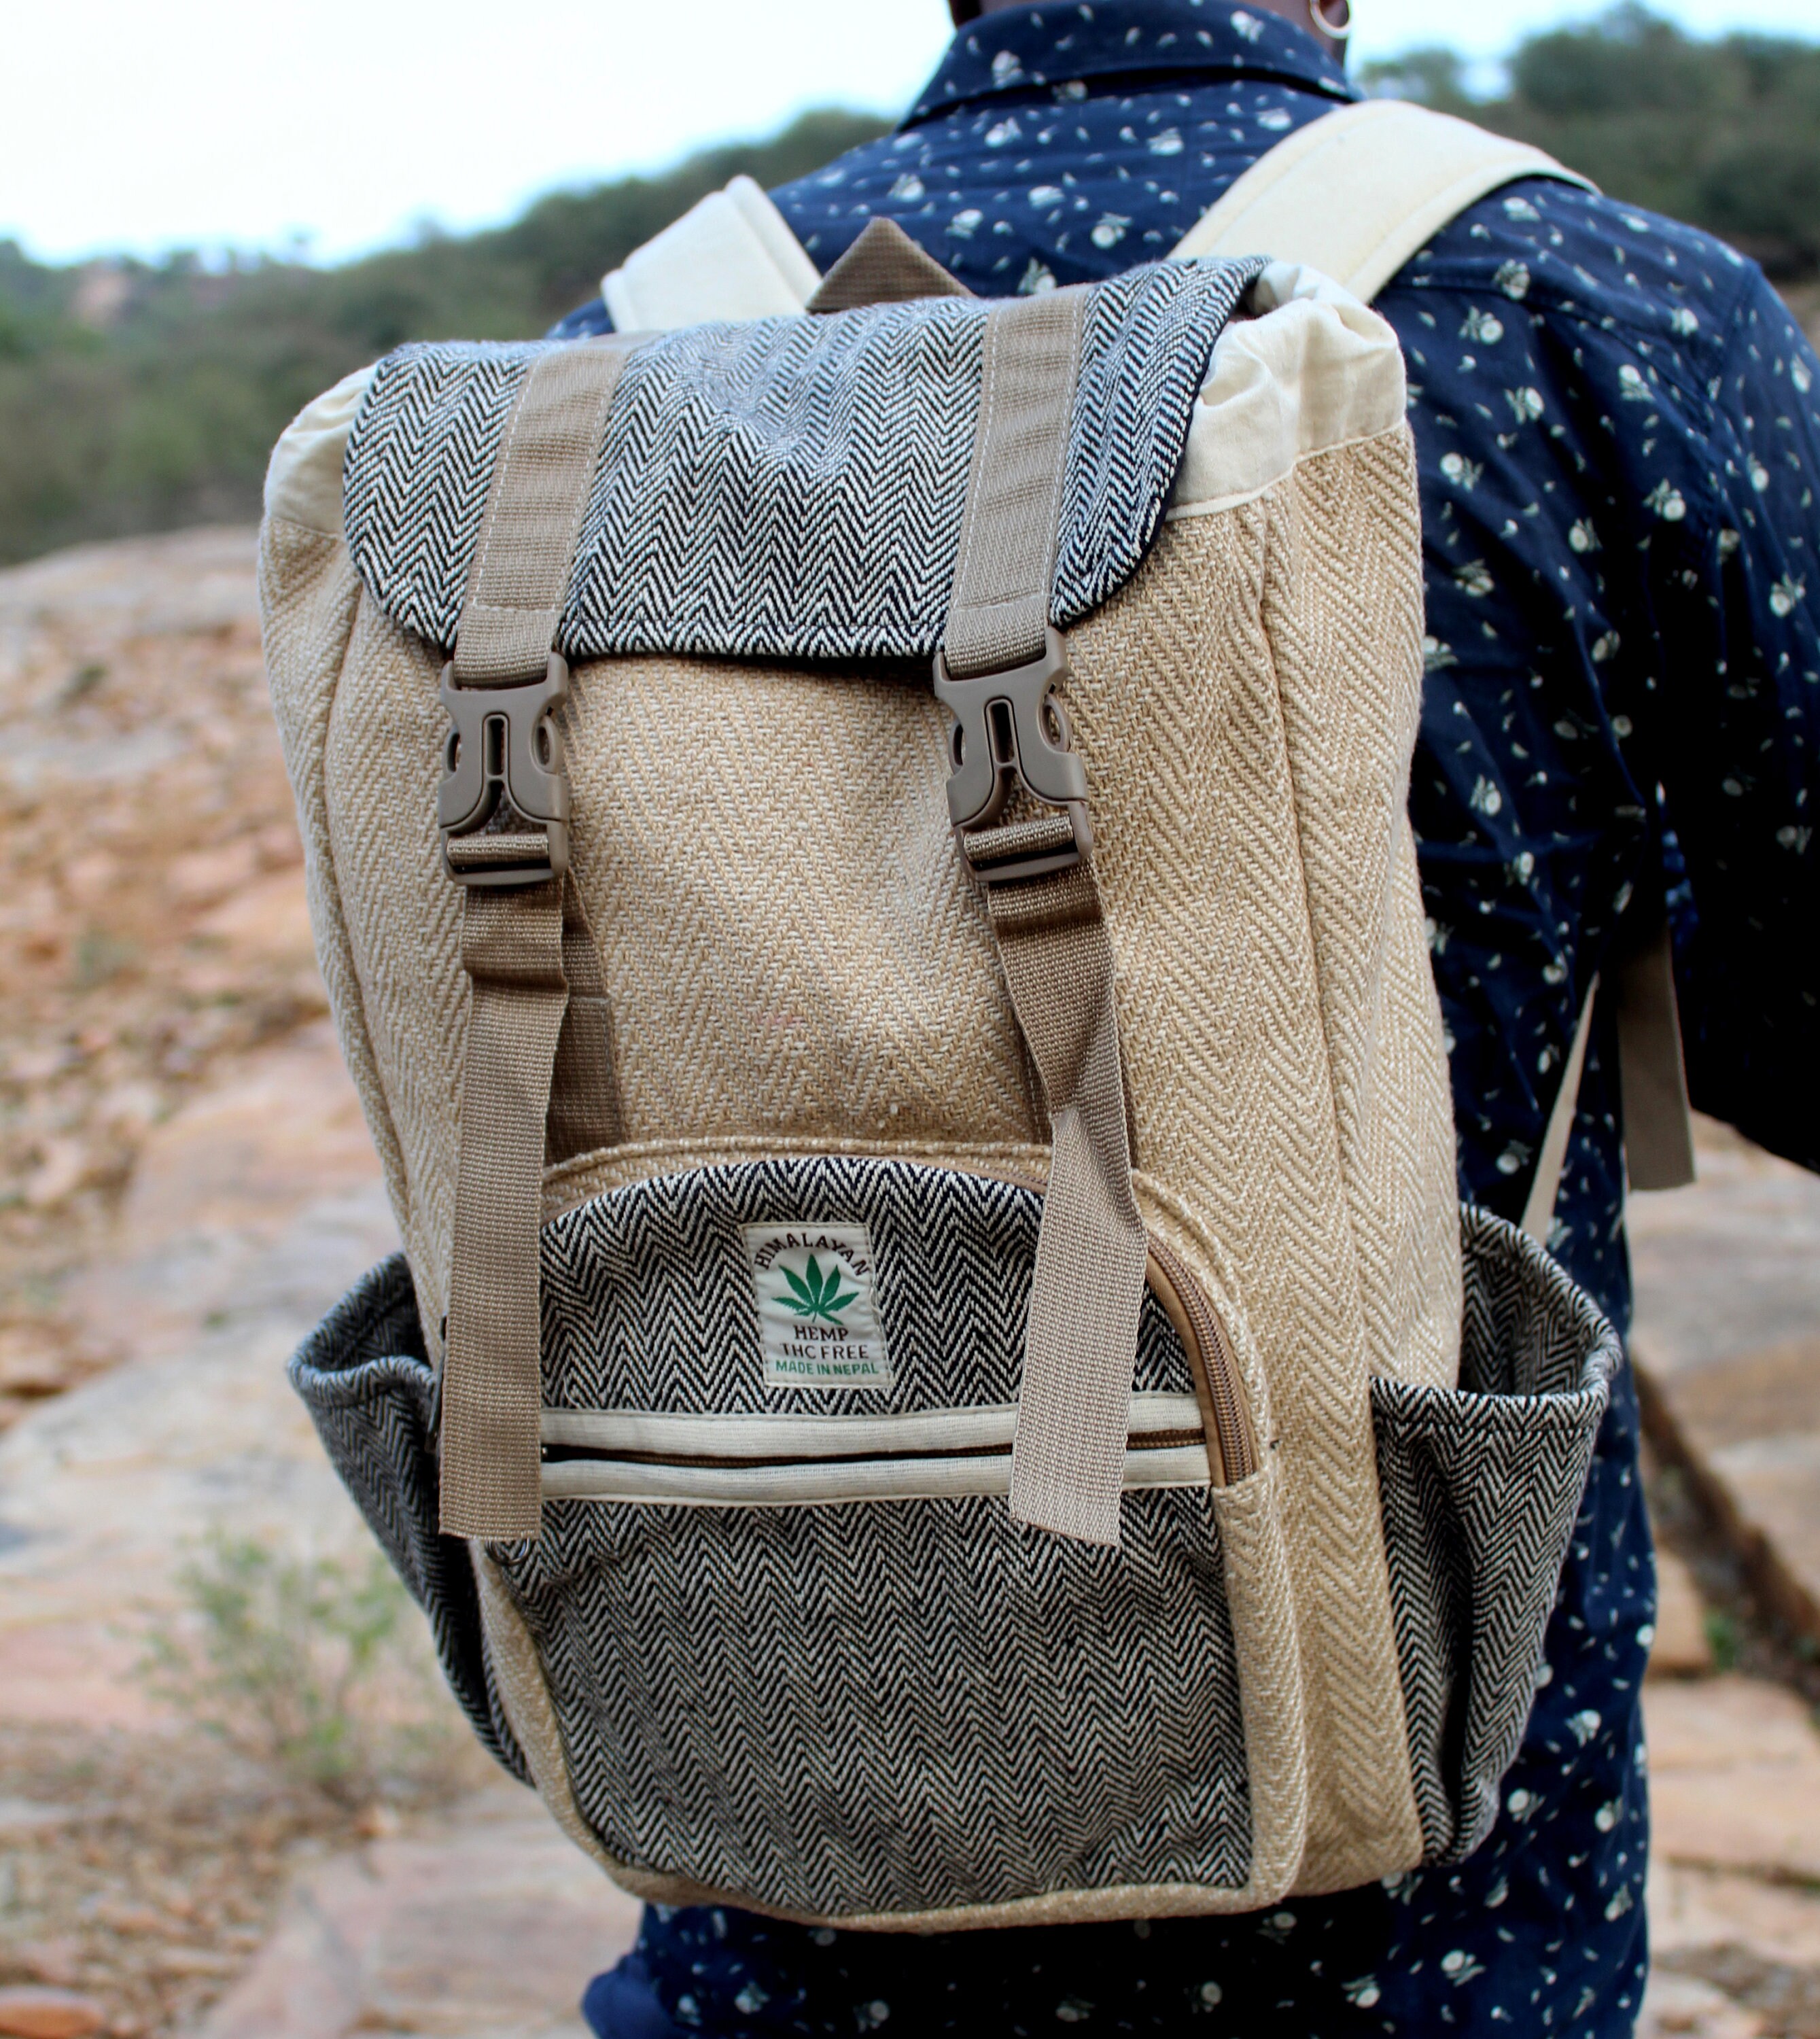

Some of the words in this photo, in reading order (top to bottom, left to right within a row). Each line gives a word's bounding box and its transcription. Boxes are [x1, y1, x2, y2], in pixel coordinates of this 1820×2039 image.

[754, 1232, 869, 1276] HIMALAYAN
[794, 1325, 848, 1341] HEMP
[781, 1343, 816, 1359] THC
[820, 1344, 869, 1359] FREE
[776, 1361, 813, 1374] MADE
[818, 1363, 830, 1374] IN
[834, 1362, 879, 1375] NEPAL
